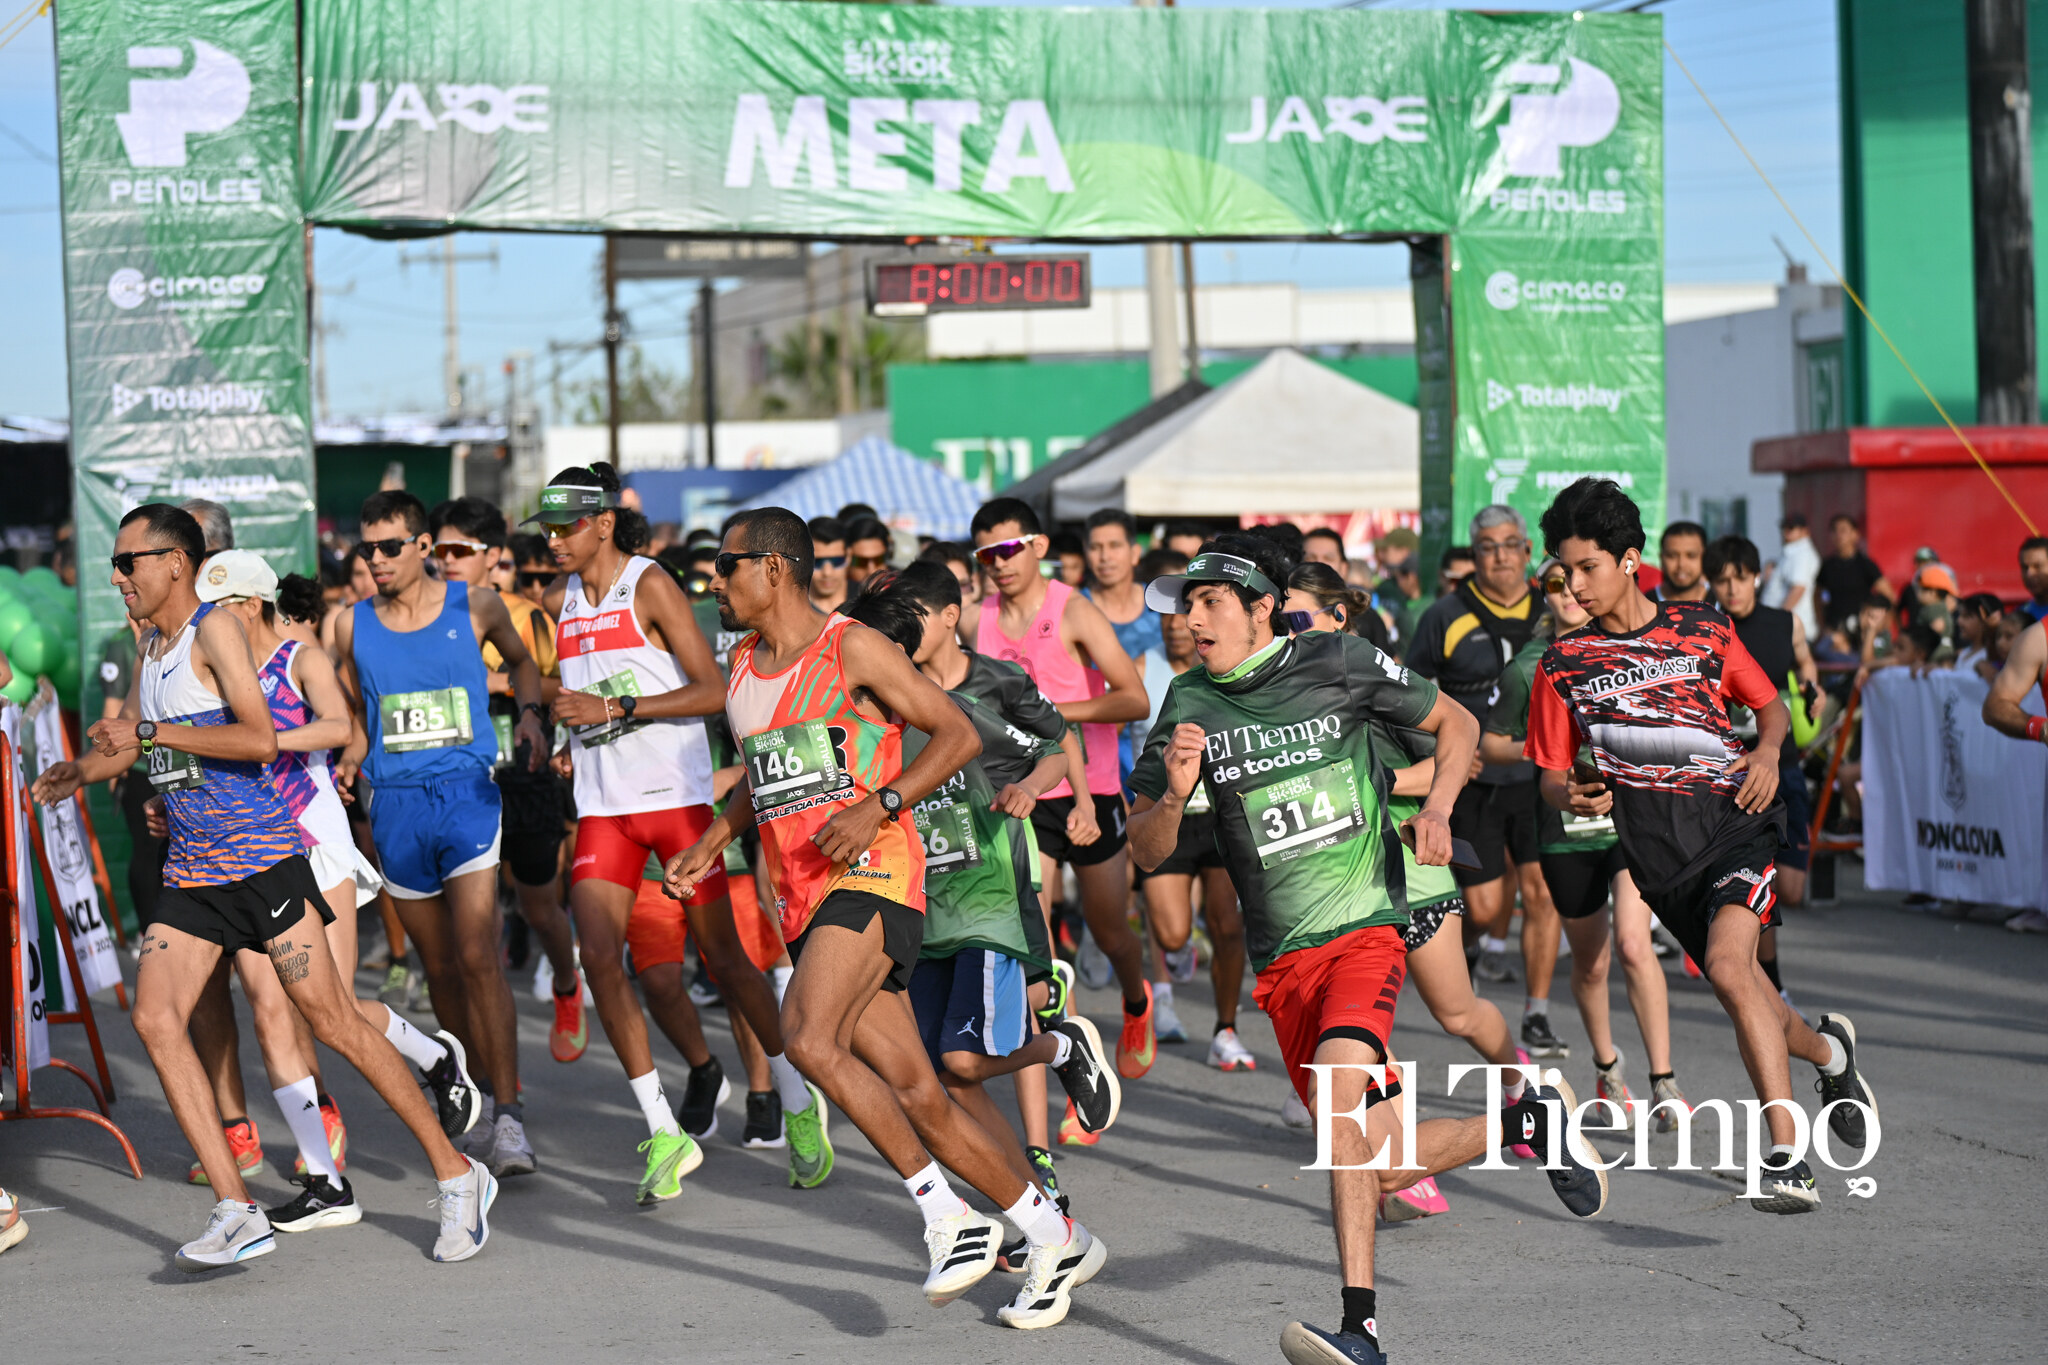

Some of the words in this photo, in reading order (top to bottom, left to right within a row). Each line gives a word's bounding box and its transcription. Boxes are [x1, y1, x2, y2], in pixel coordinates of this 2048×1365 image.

[724, 94, 1075, 192] META
[148, 383, 264, 414] Totalplay
[1516, 382, 1621, 413] Totalplay
[1589, 656, 1699, 694] IRONCAST
[392, 706, 445, 734] 185
[811, 723, 824, 731] 146
[754, 730, 784, 742] CARRERA
[1205, 730, 1234, 763] El
[1234, 715, 1341, 754] Tiempo
[148, 746, 173, 775] 287
[753, 747, 803, 784] 146
[817, 734, 837, 782] MEDALLA
[1213, 766, 1241, 784] de
[1242, 747, 1323, 775] todos
[1267, 776, 1310, 794] CARRERA
[780, 800, 814, 816] LETICIA
[815, 790, 855, 808] ROCHA
[911, 797, 953, 814] dos
[1262, 791, 1336, 840] 314
[1346, 776, 1364, 826] MEDALLA
[961, 817, 978, 860] MEDALLA
[844, 869, 892, 880] NCLOVA
